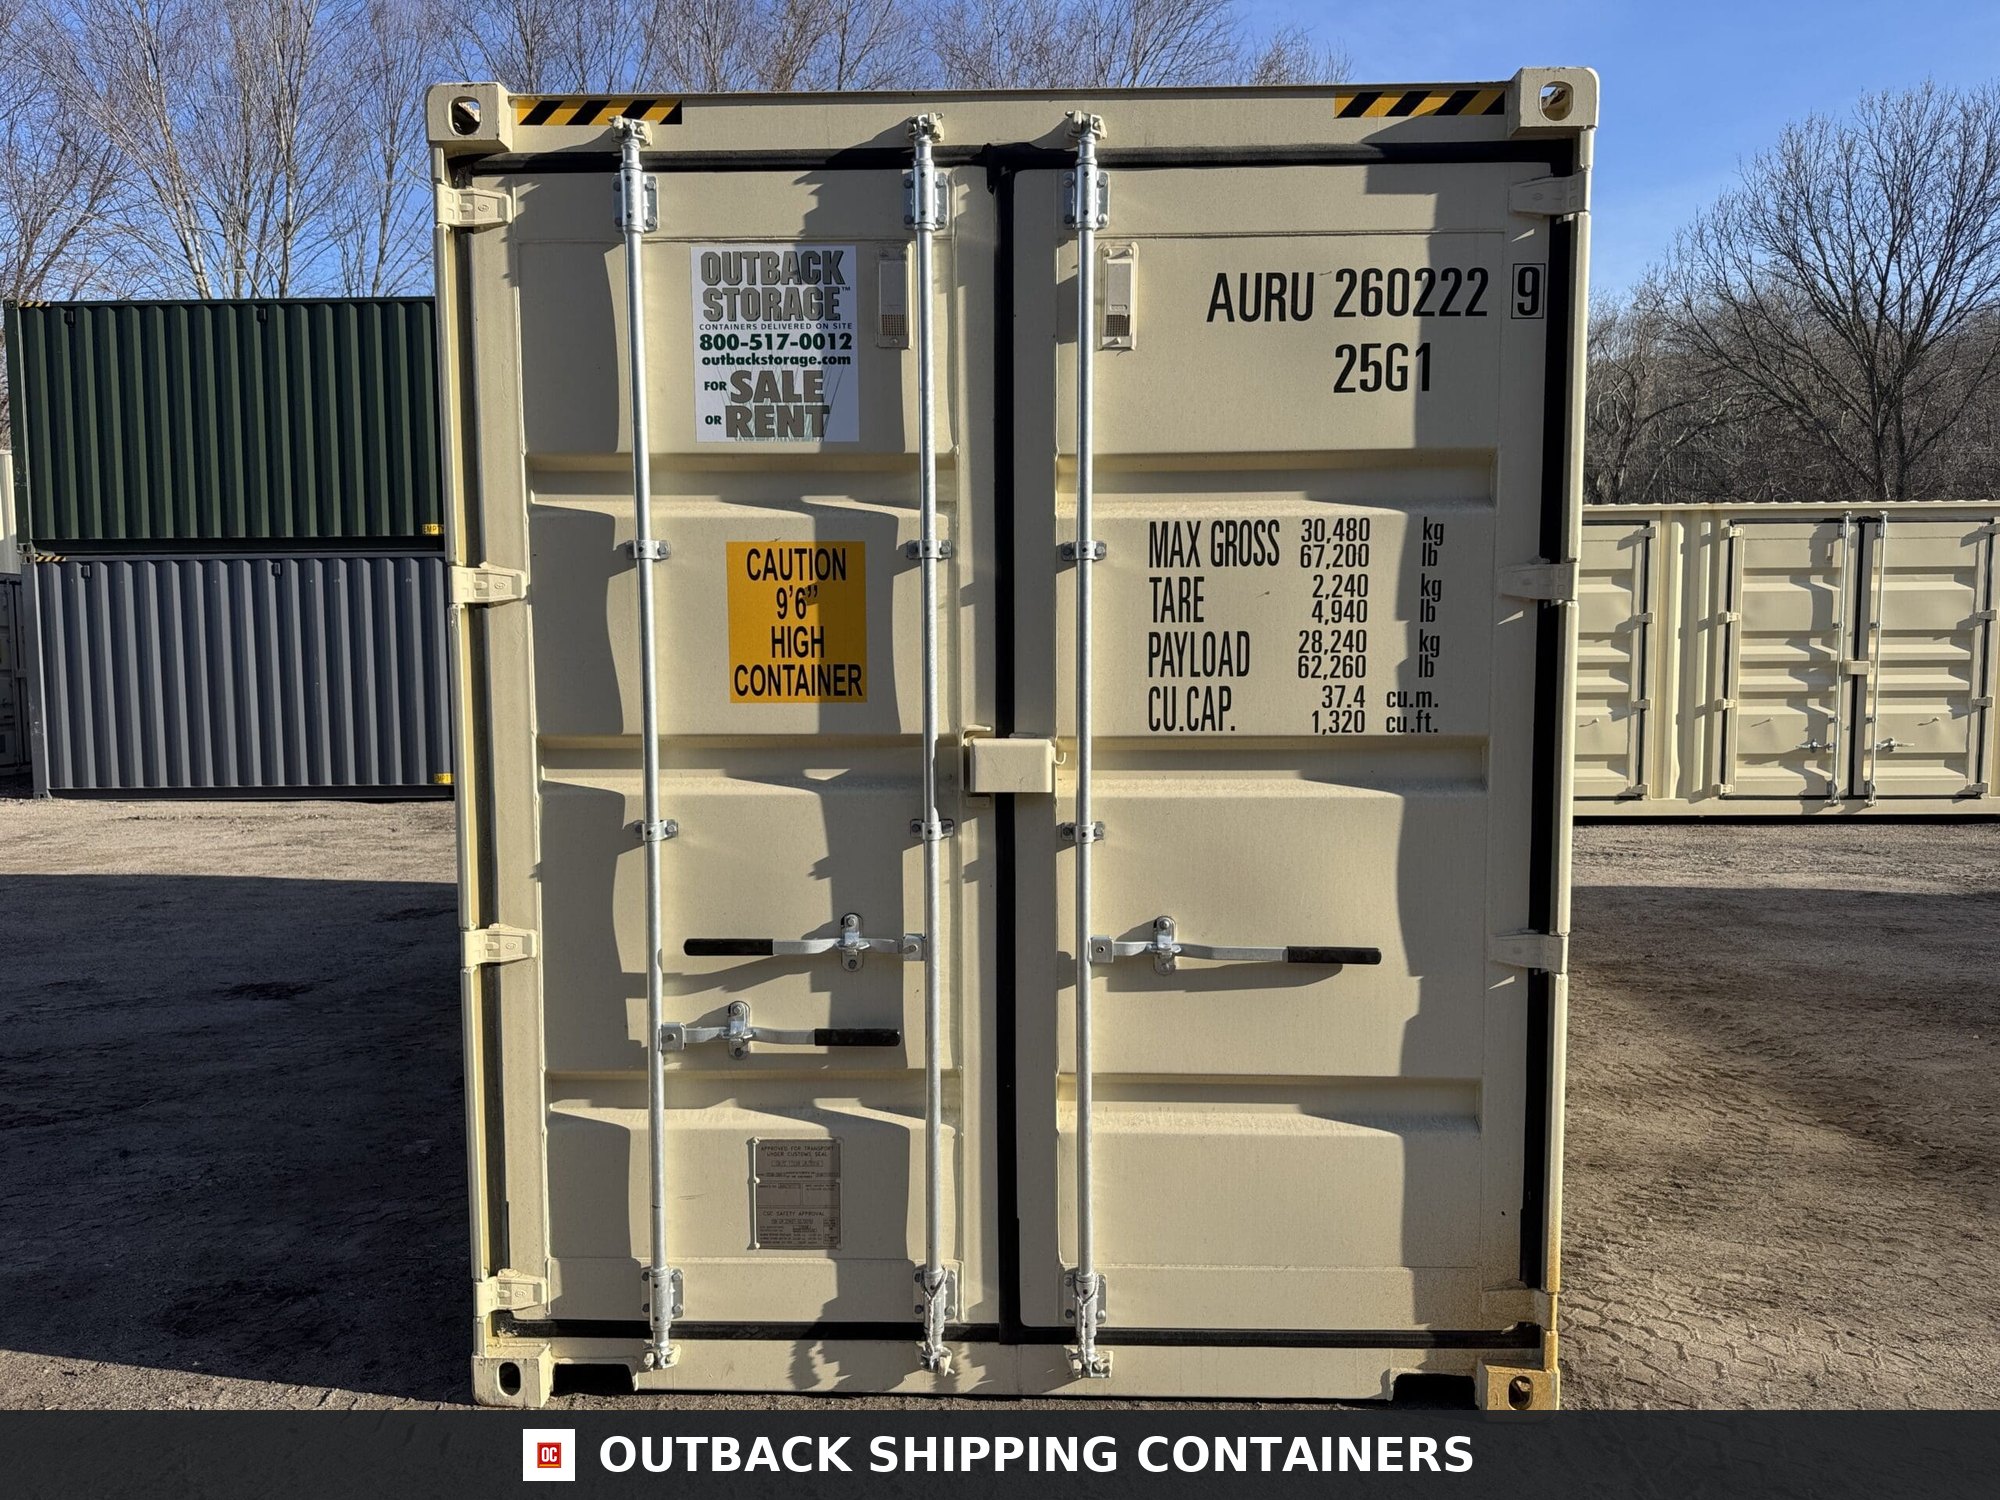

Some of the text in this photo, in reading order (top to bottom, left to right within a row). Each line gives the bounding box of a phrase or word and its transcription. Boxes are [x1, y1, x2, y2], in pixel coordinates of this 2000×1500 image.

[700, 250, 845, 286] OUTBACK
[702, 286, 841, 322] STORAGE
[1206, 266, 1541, 323] AURU 260222 9
[699, 322, 853, 331] CONTAINERS DELIVERED ON SITE
[699, 332, 852, 351] 800-517-0012
[701, 353, 851, 367] outbackstorage.com
[1333, 342, 1431, 393] 25G1
[704, 370, 825, 404] FOR SALE
[704, 405, 831, 438] OR RENT
[1148, 516, 1445, 569] MAX GROSS 30,480 kg
[1300, 542, 1438, 570] 67,200 lb
[746, 548, 847, 581] CAUTION
[1149, 573, 1442, 623] TARE 2,240 kg
[1311, 598, 1436, 626] 4,940 lb
[771, 626, 825, 659] HIGH
[1148, 629, 1441, 678] PAYLOAD 28,240 kg
[734, 664, 863, 697] CONTAINER
[1297, 654, 1434, 681] 62,260 lb
[1148, 685, 1439, 732] CU.CAP. 37.4 cu.m.
[1311, 710, 1439, 736] 1,320 cu.ft.
